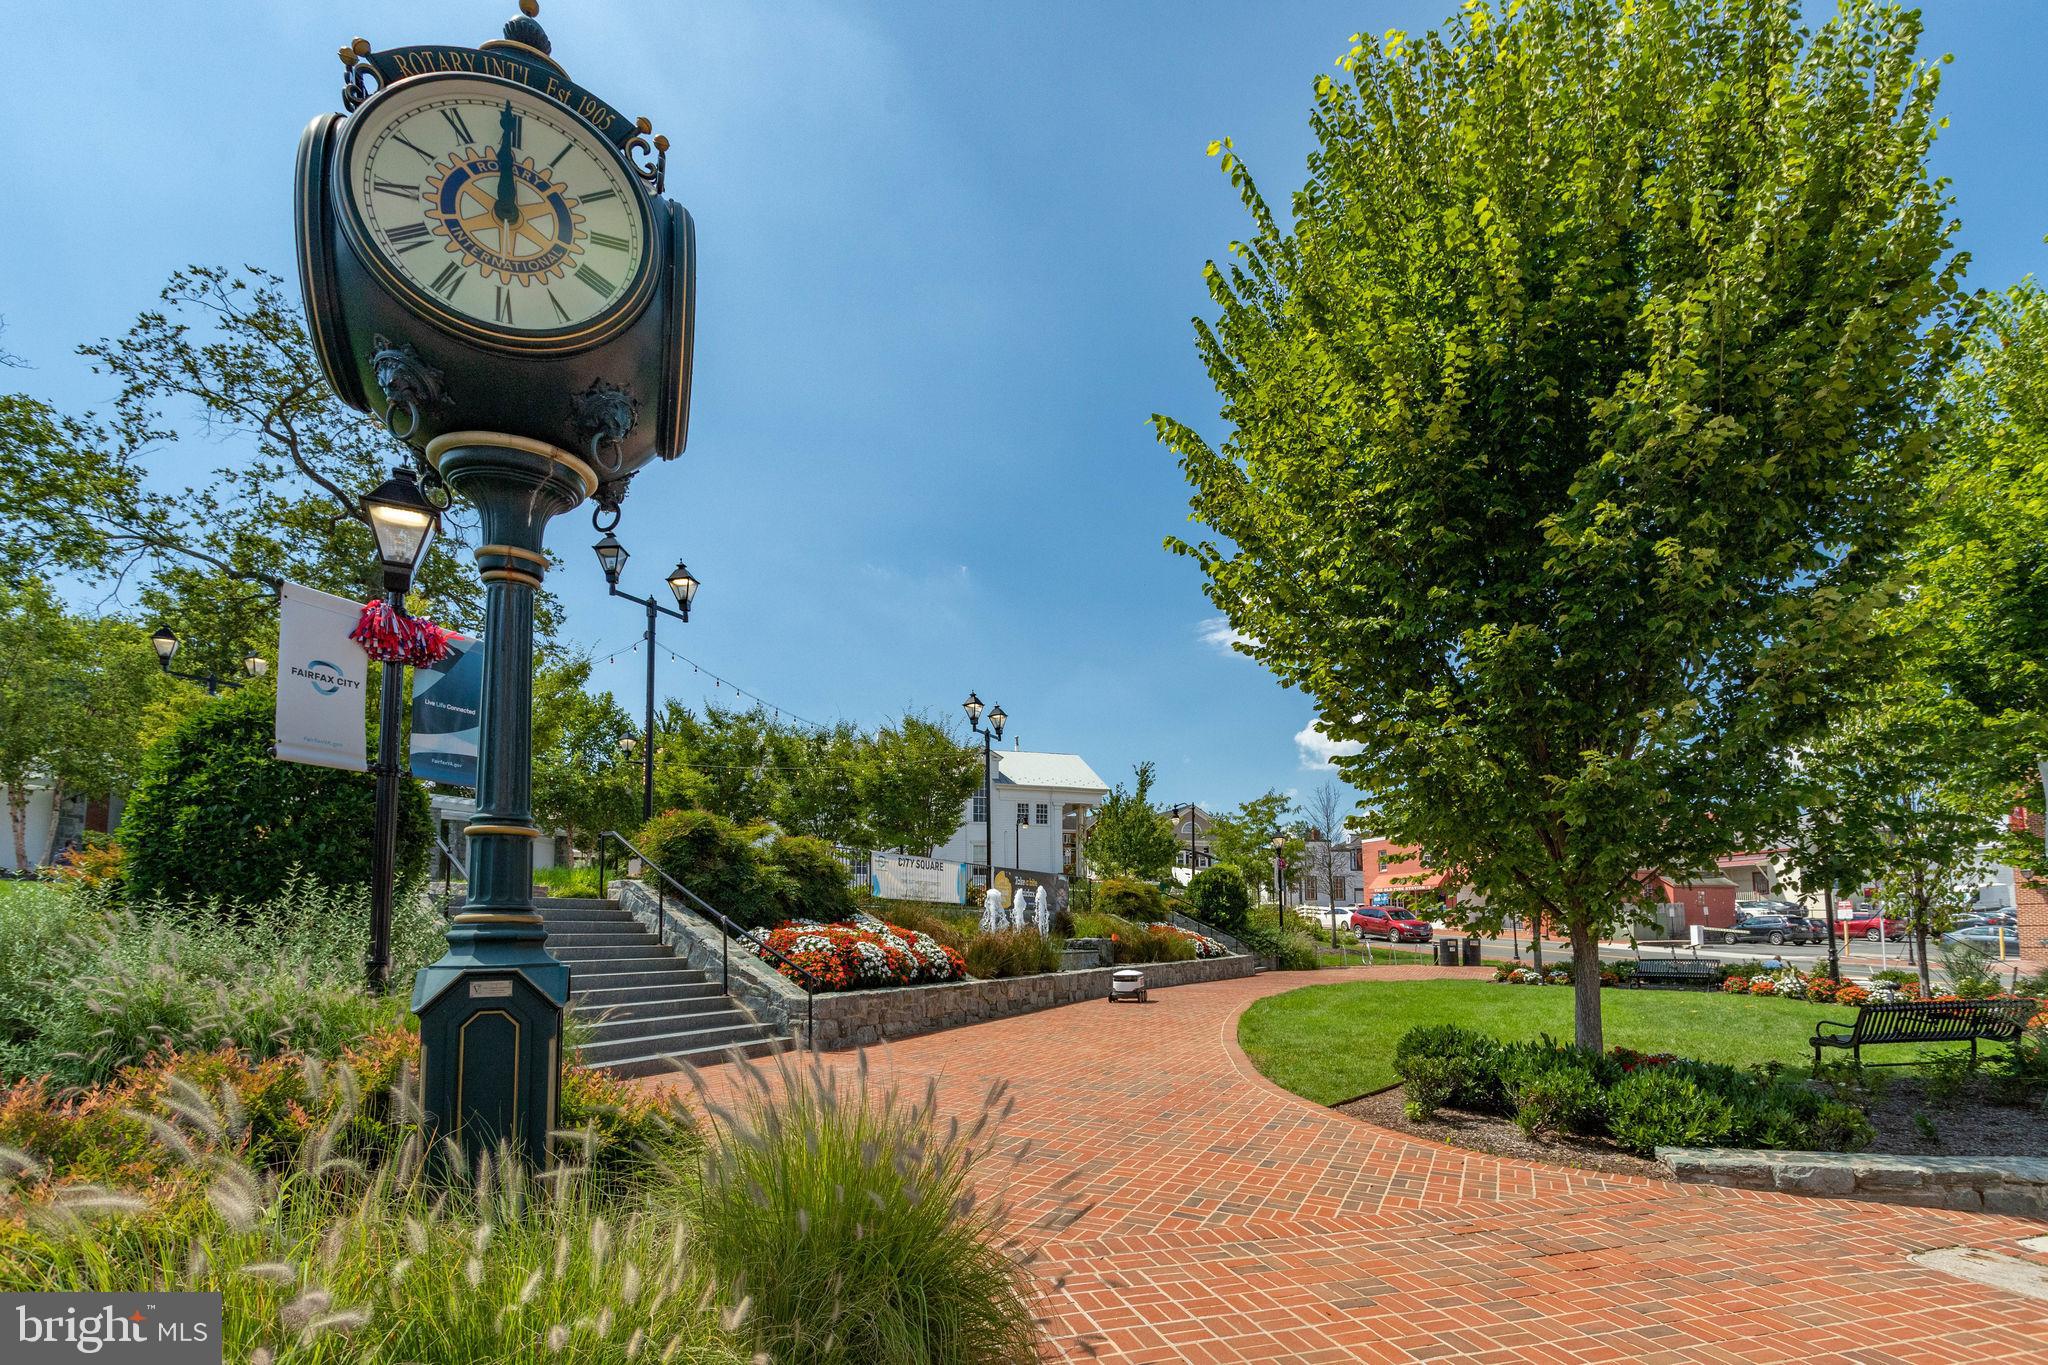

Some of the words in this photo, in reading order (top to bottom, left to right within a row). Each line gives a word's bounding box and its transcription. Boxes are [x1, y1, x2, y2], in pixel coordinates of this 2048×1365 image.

[393, 51, 475, 77] ROTARY
[577, 96, 616, 130] 1905
[477, 160, 541, 185] ROARY
[450, 226, 563, 272] INTERNATIONAL
[291, 666, 335, 684] FAIRFAX
[336, 677, 361, 689] CITY
[424, 698, 436, 707] Live
[436, 701, 447, 709] Life
[446, 703, 477, 715] Connected
[898, 857, 916, 868] CITY
[915, 860, 944, 872] SQUARE
